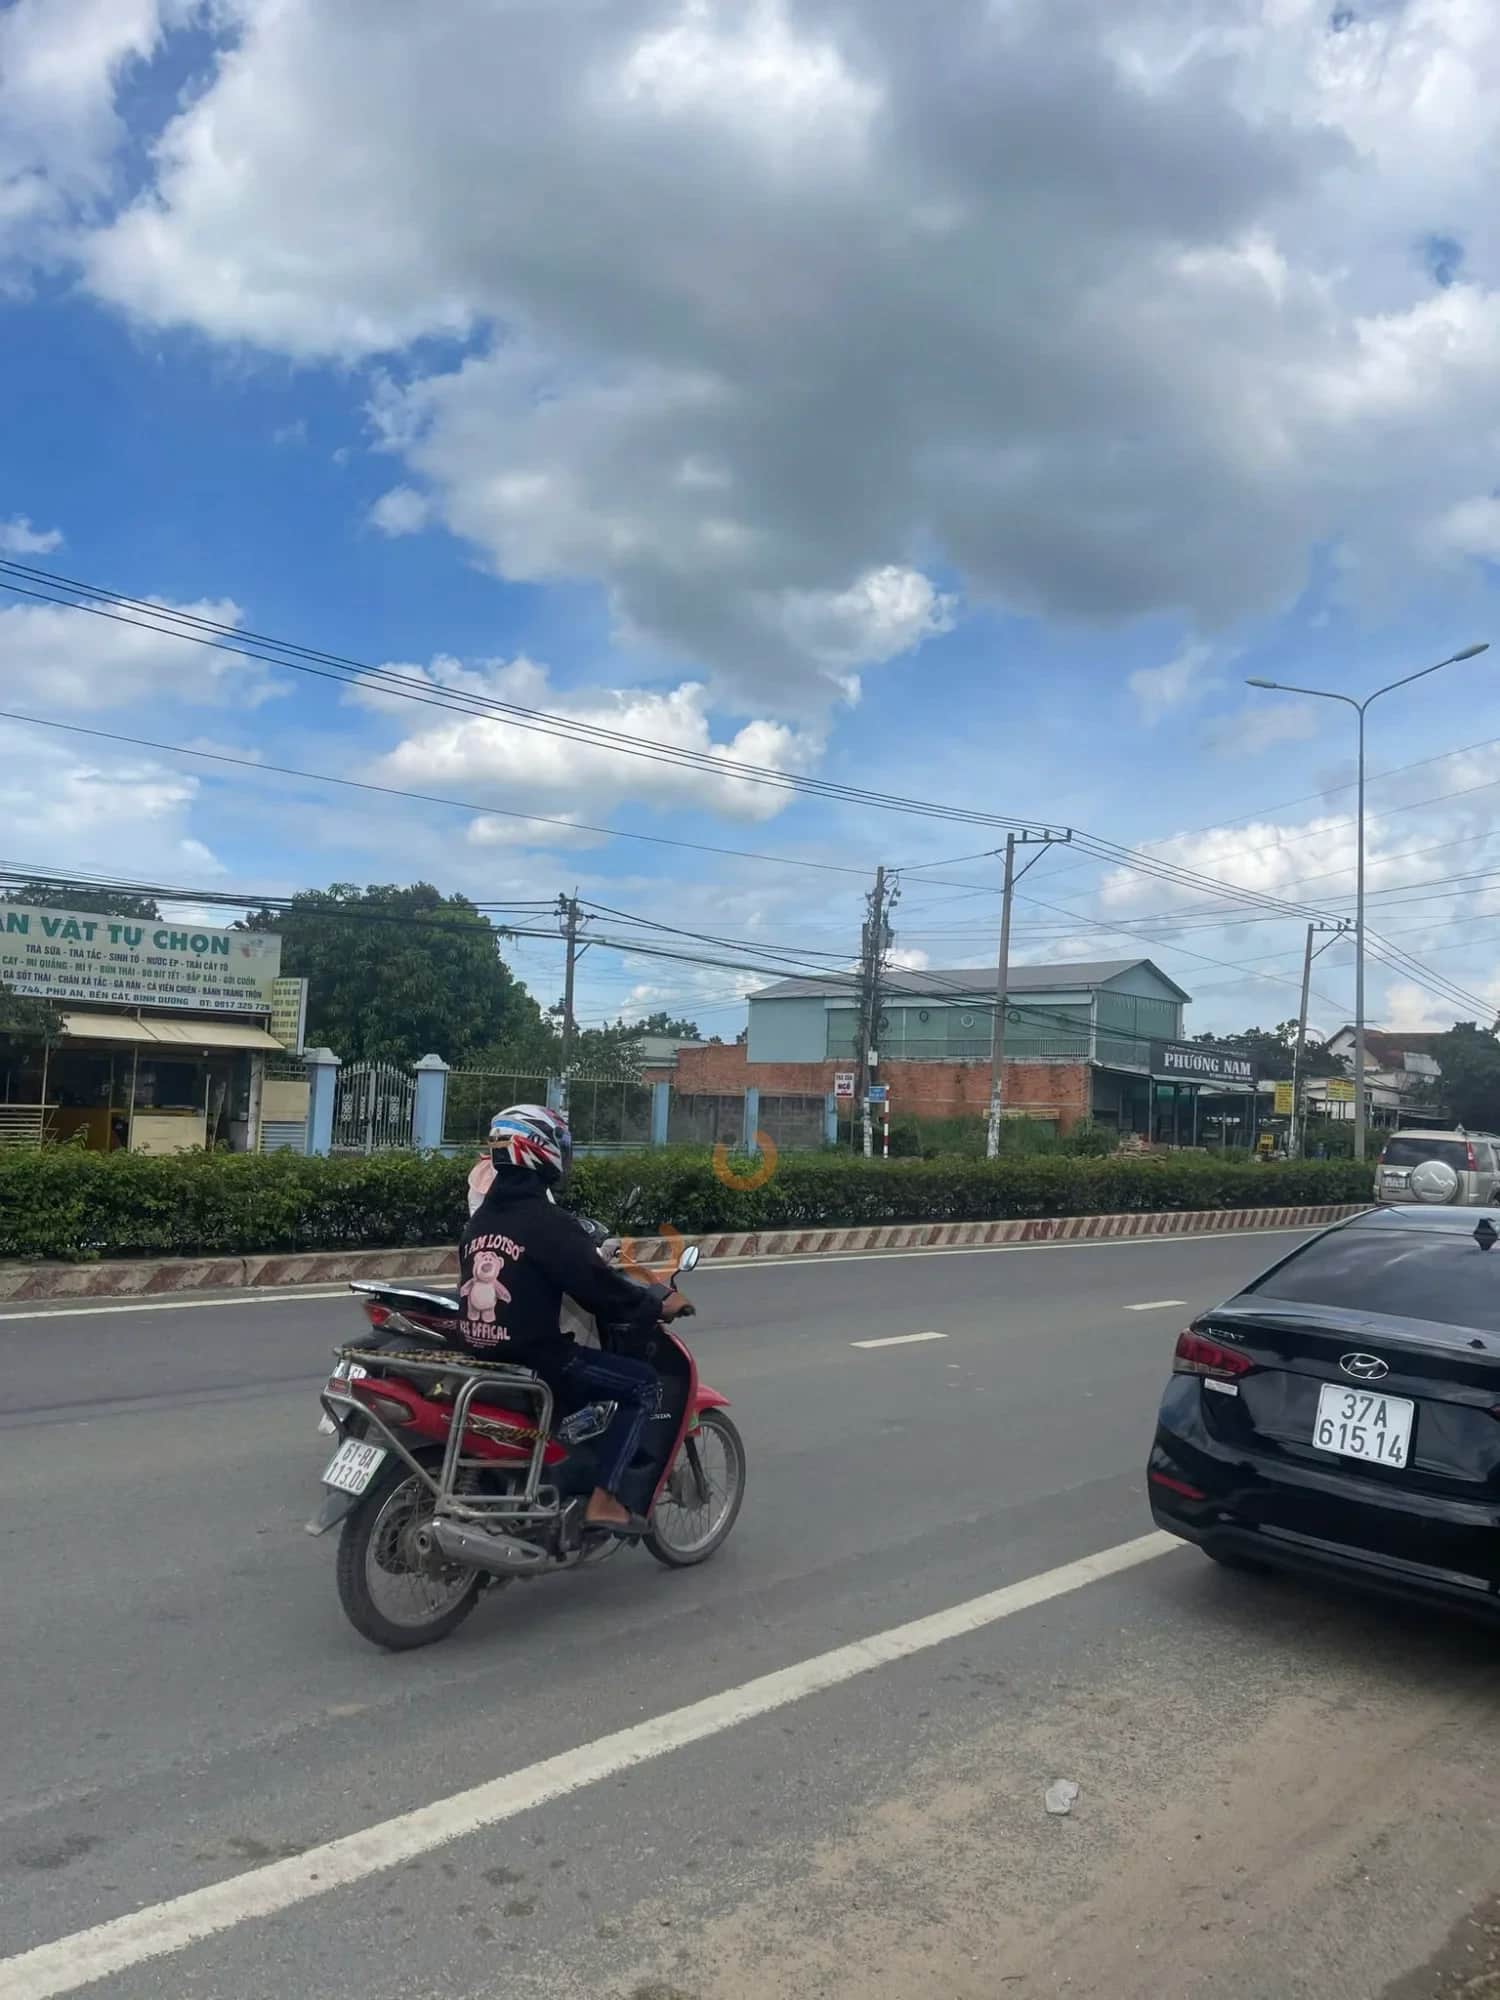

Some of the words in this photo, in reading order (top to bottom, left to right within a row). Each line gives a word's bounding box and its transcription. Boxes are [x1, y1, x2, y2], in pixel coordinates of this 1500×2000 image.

[153, 929, 230, 957] CHỌN
[1164, 1053, 1219, 1072] PHƯƠNG
[1224, 1060, 1251, 1075] NAM
[469, 1235, 488, 1254] AM
[1341, 1393, 1387, 1428] 37A
[1319, 1419, 1402, 1463] 615.14
